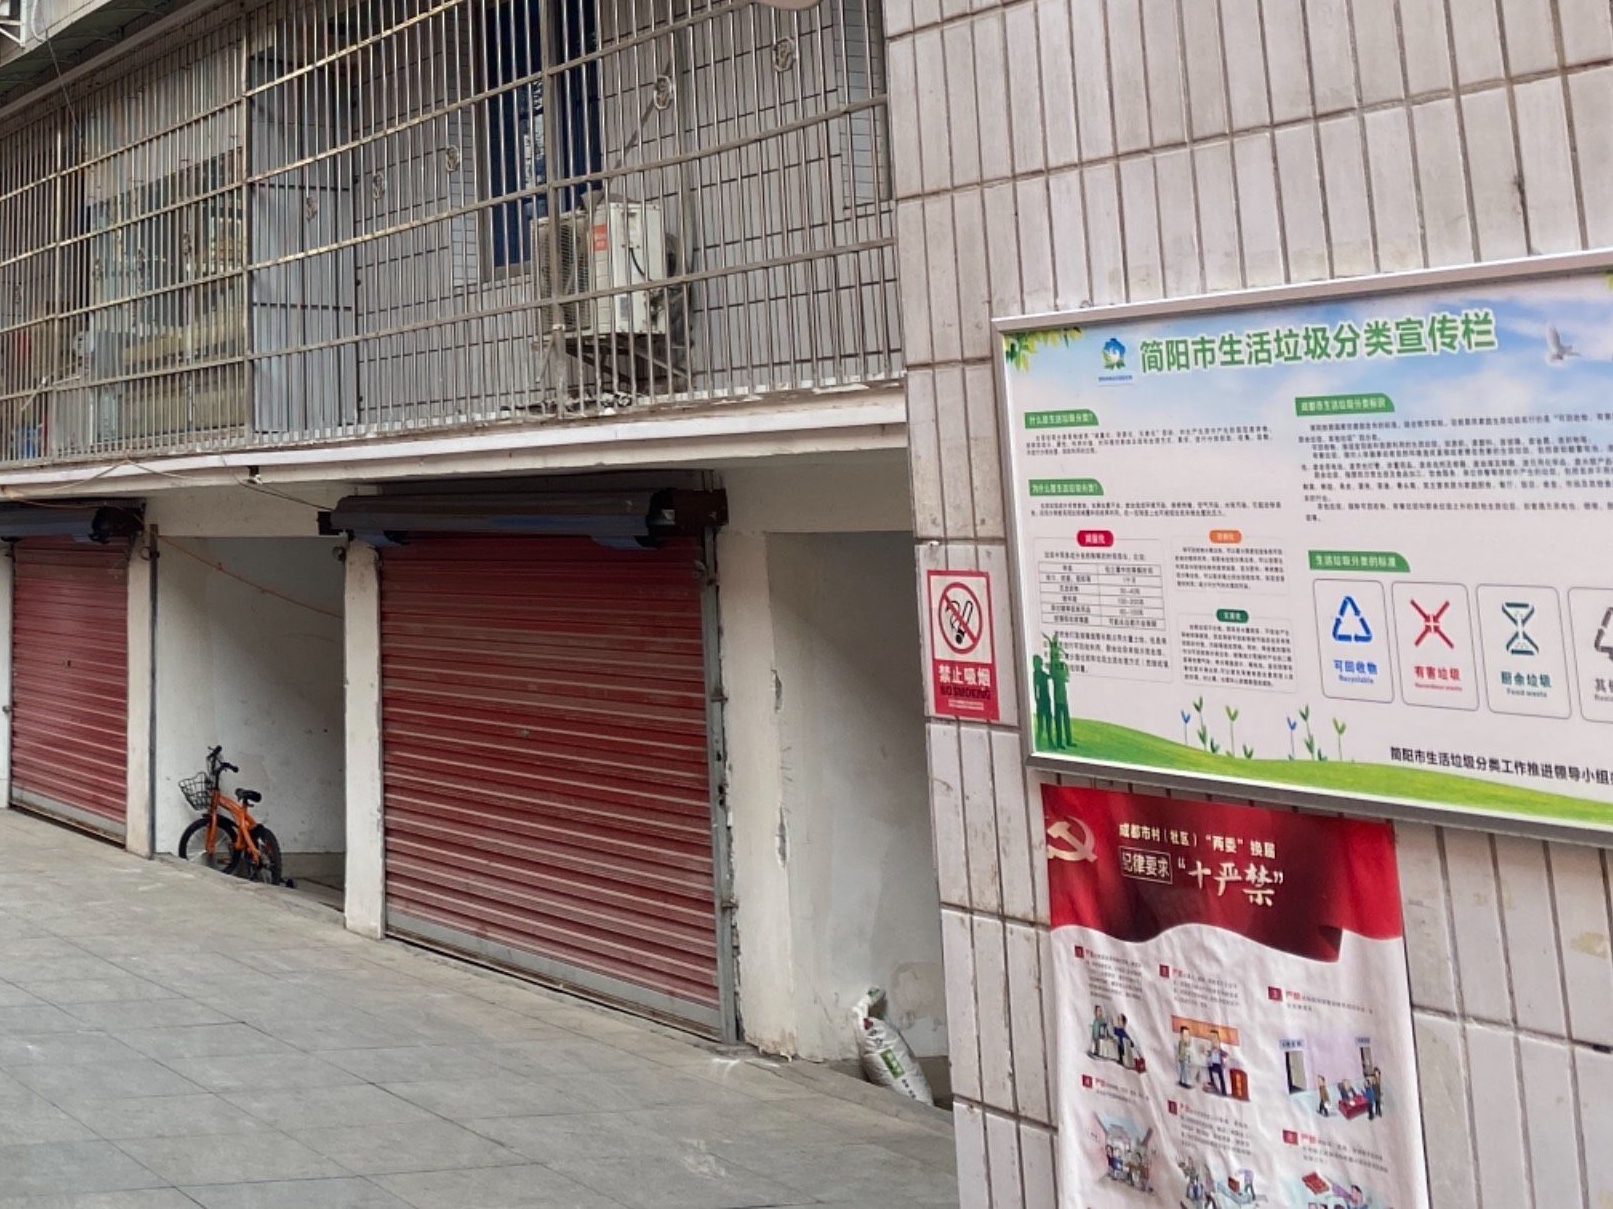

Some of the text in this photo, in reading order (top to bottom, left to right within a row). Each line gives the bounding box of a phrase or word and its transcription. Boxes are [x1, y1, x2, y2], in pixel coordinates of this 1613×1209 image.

[1138, 311, 1497, 374] 简阳市生活垃圾分类宣传栏
[938, 664, 991, 687] 禁止吸烟
[1333, 659, 1378, 675] 可回收物
[1414, 665, 1461, 681] 有害垃圾
[1501, 671, 1552, 688] 厨余垃圾
[1390, 746, 1613, 786] 简阳市生活垃圾分类工作推进领导小组
[1122, 851, 1170, 879] 纪律要求
